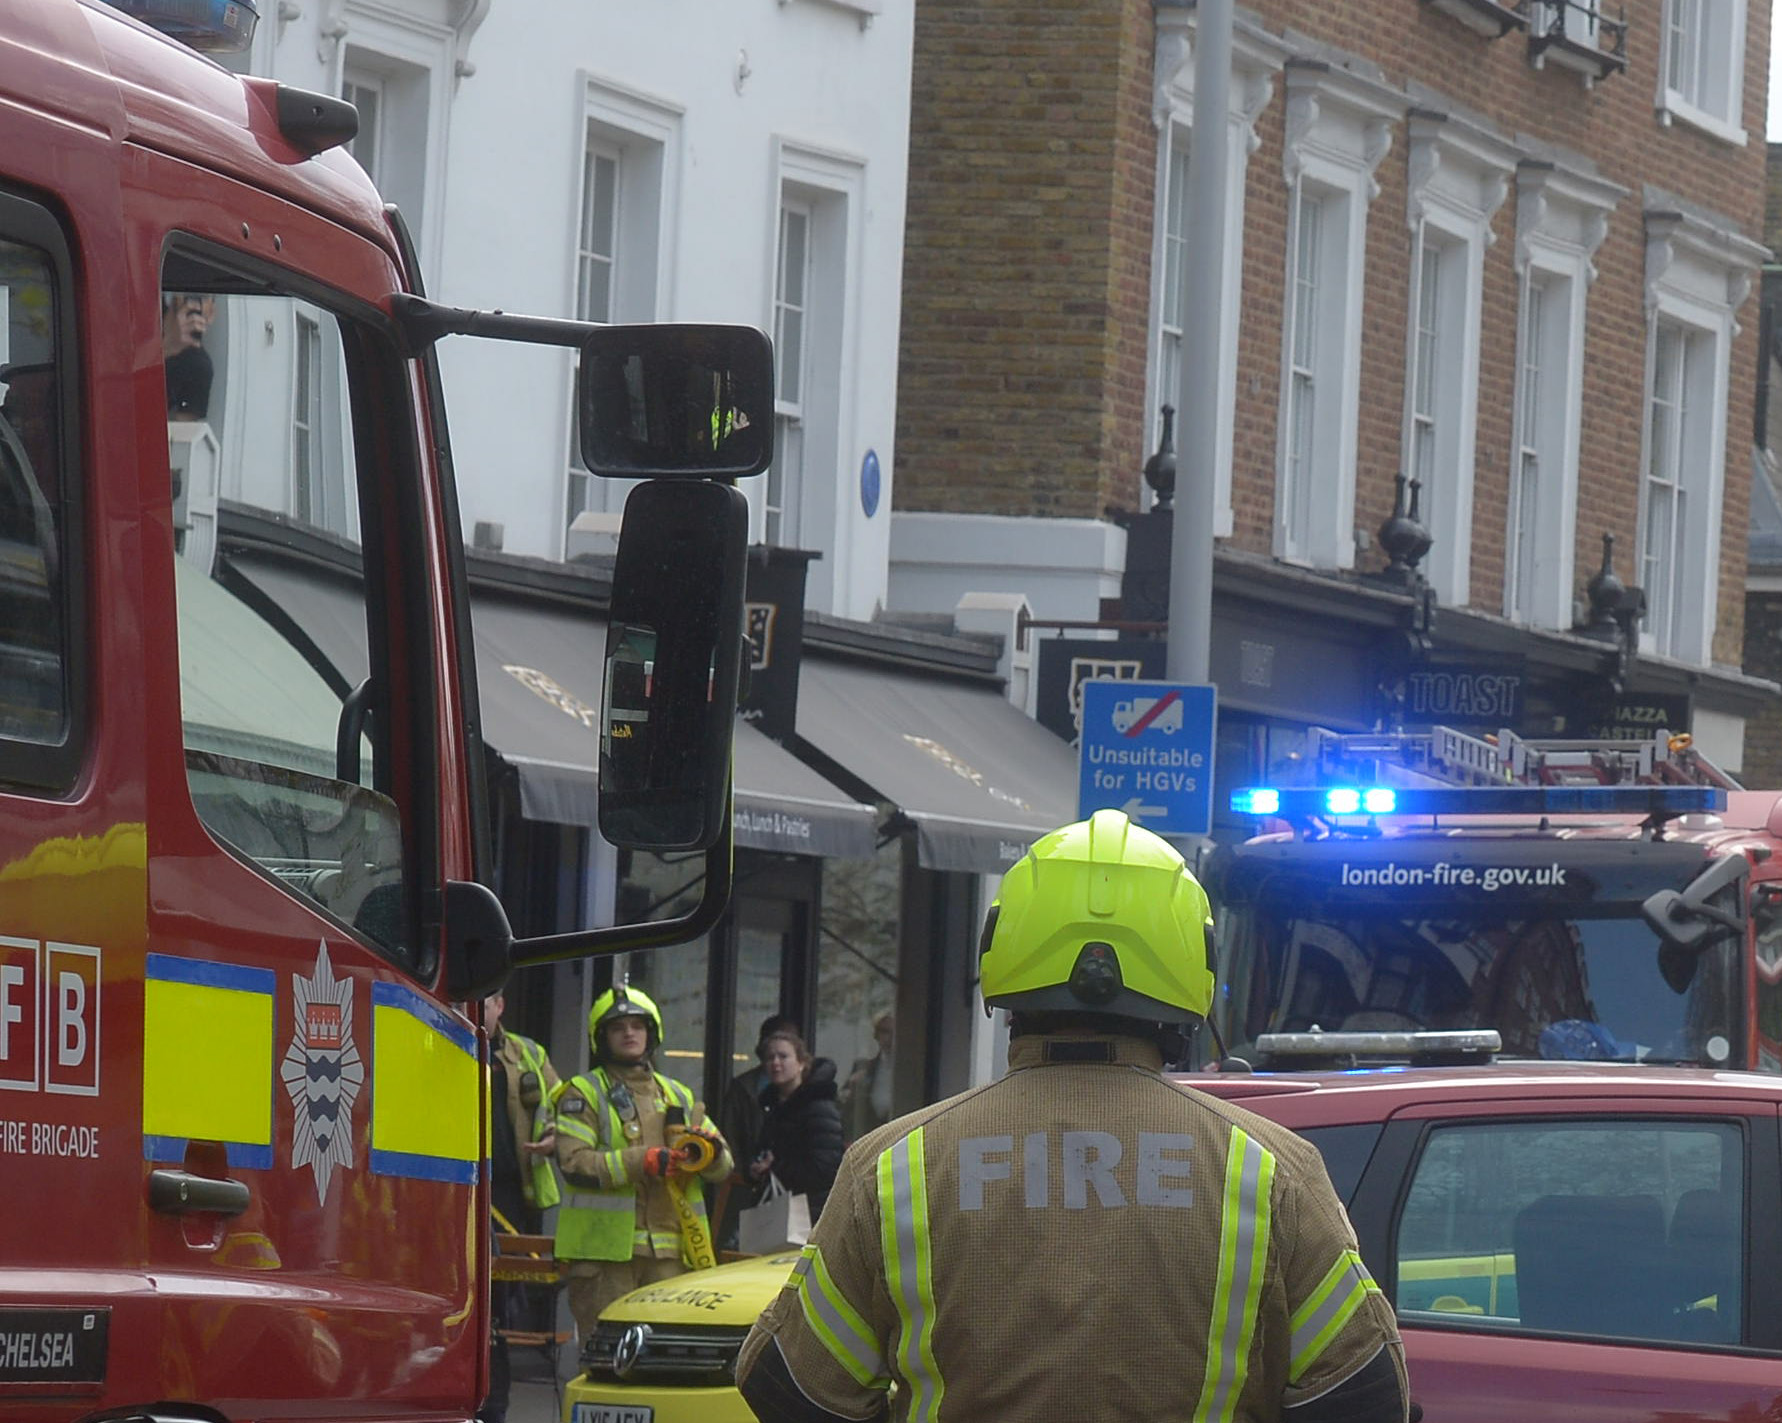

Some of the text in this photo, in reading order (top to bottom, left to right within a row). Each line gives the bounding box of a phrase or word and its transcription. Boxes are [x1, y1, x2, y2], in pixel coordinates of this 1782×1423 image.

[1410, 671, 1520, 717] TOAST
[1608, 705, 1669, 723] IAZZA
[1088, 745, 1204, 768] Unsuitable
[1094, 769, 1197, 792] for HGVs
[1341, 862, 1566, 891] london-fire.gov.uk
[31, 1122, 100, 1158] BRIGADE
[959, 1130, 1194, 1211] FIRE
